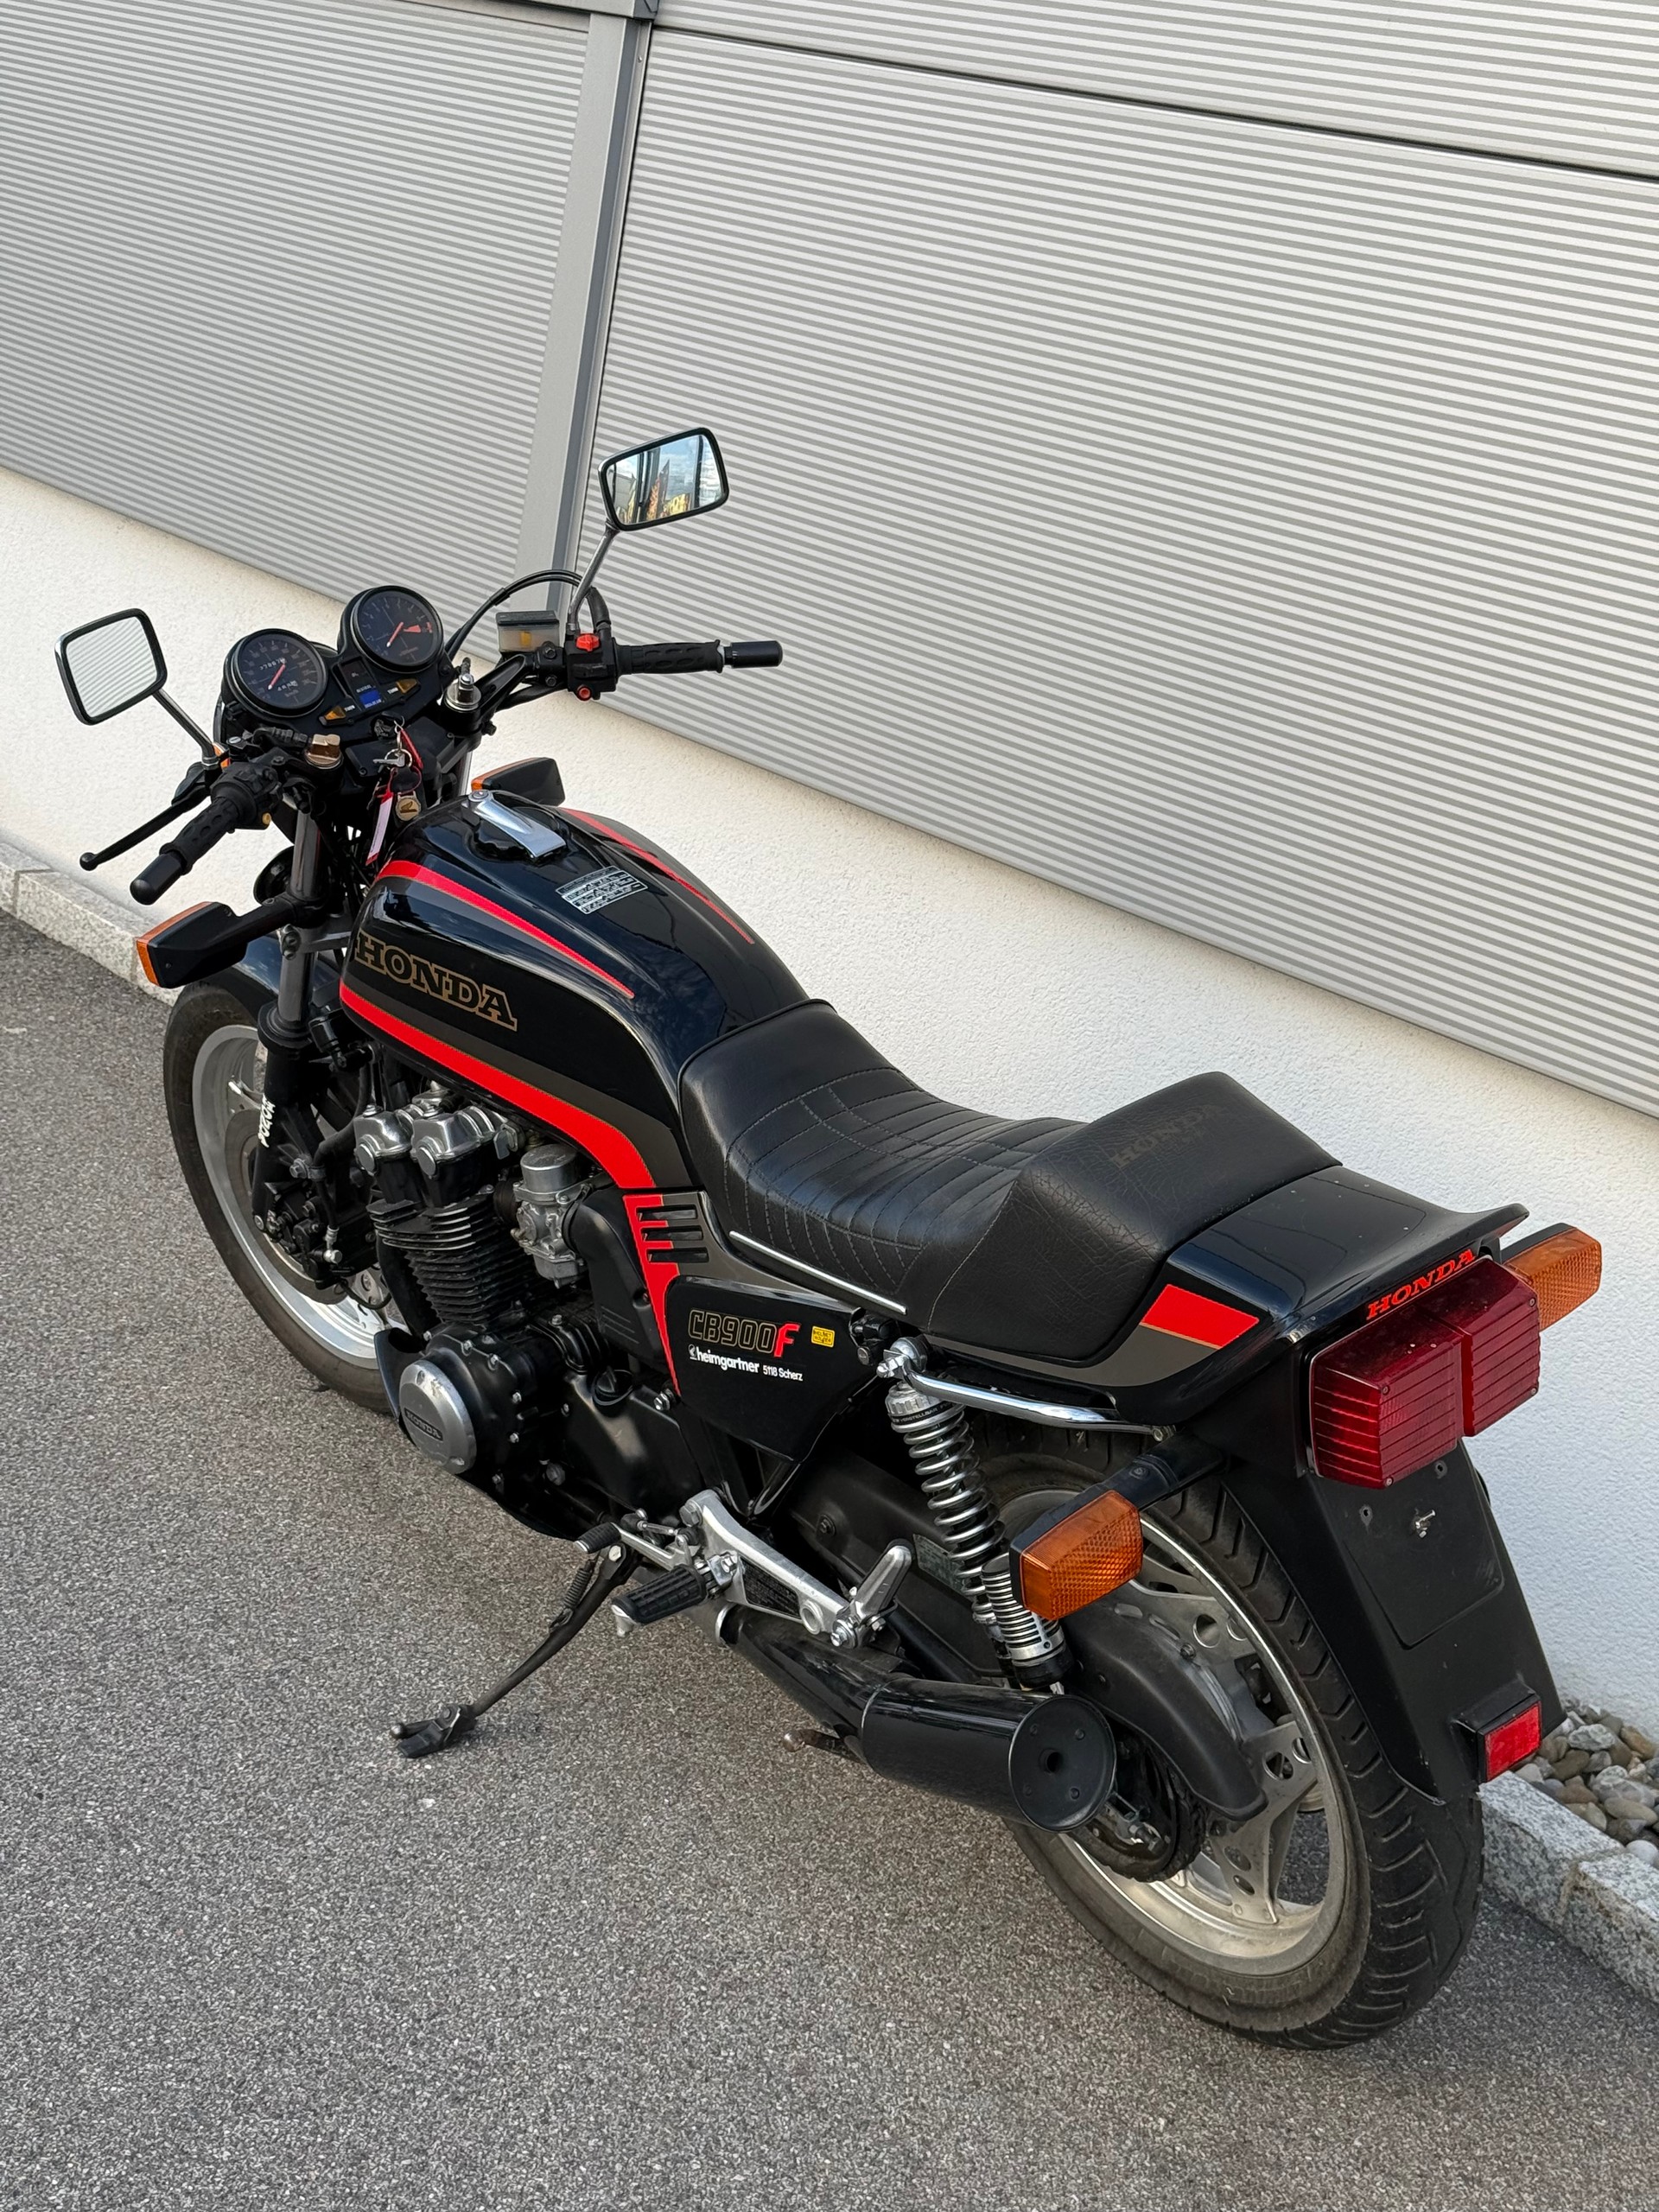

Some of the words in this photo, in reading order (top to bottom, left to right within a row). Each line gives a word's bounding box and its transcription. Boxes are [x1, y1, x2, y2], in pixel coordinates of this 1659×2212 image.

[354, 928, 518, 1032] HONDA
[1366, 1249, 1476, 1320] HONDA
[688, 1309, 802, 1357] CB900F
[696, 1346, 760, 1373] heimgartner
[762, 1364, 779, 1376] 5118
[778, 1368, 804, 1382] Scherz
